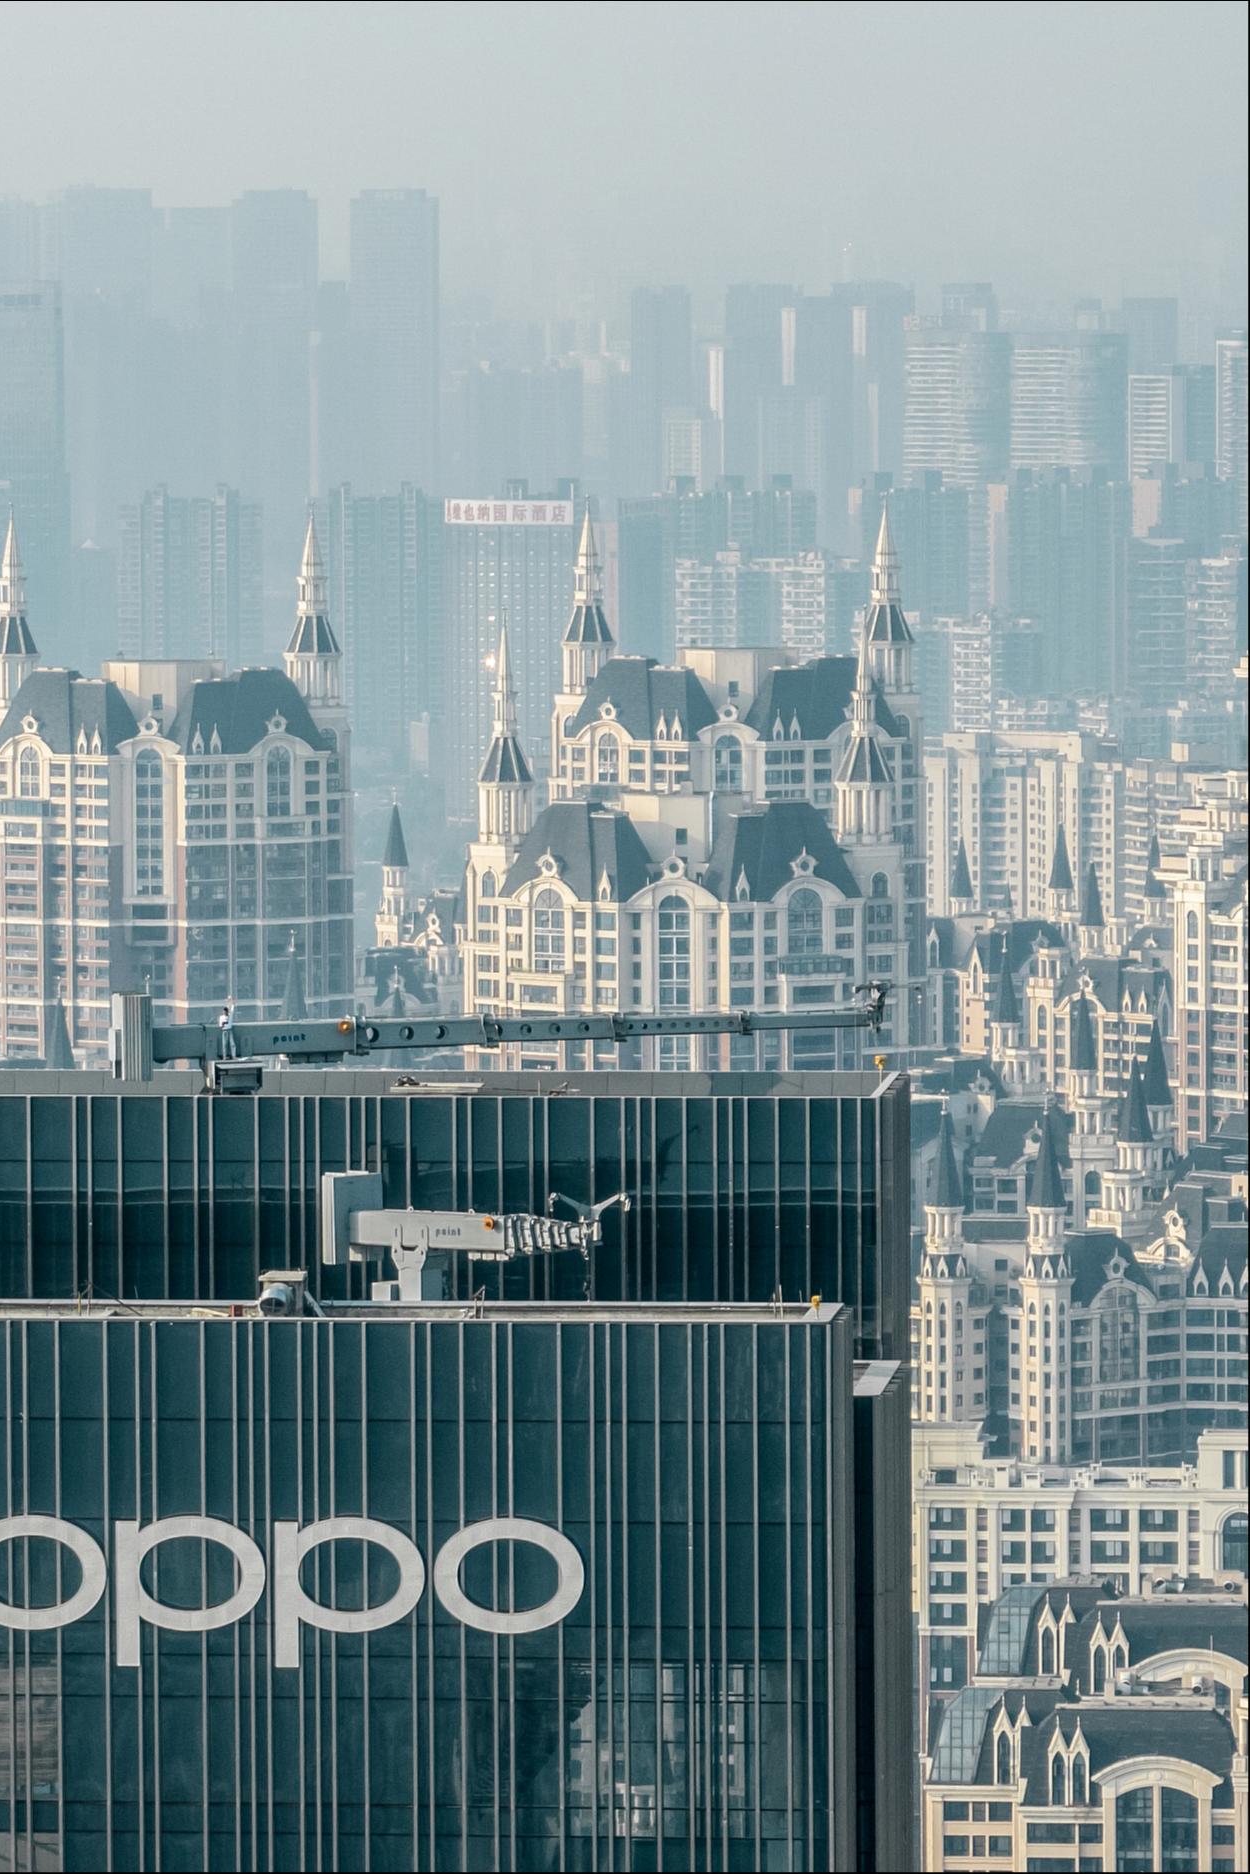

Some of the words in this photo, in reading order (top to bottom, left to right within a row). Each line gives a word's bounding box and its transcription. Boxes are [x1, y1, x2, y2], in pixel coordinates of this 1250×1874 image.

[453, 503, 567, 522] 维也纳国际酒店
